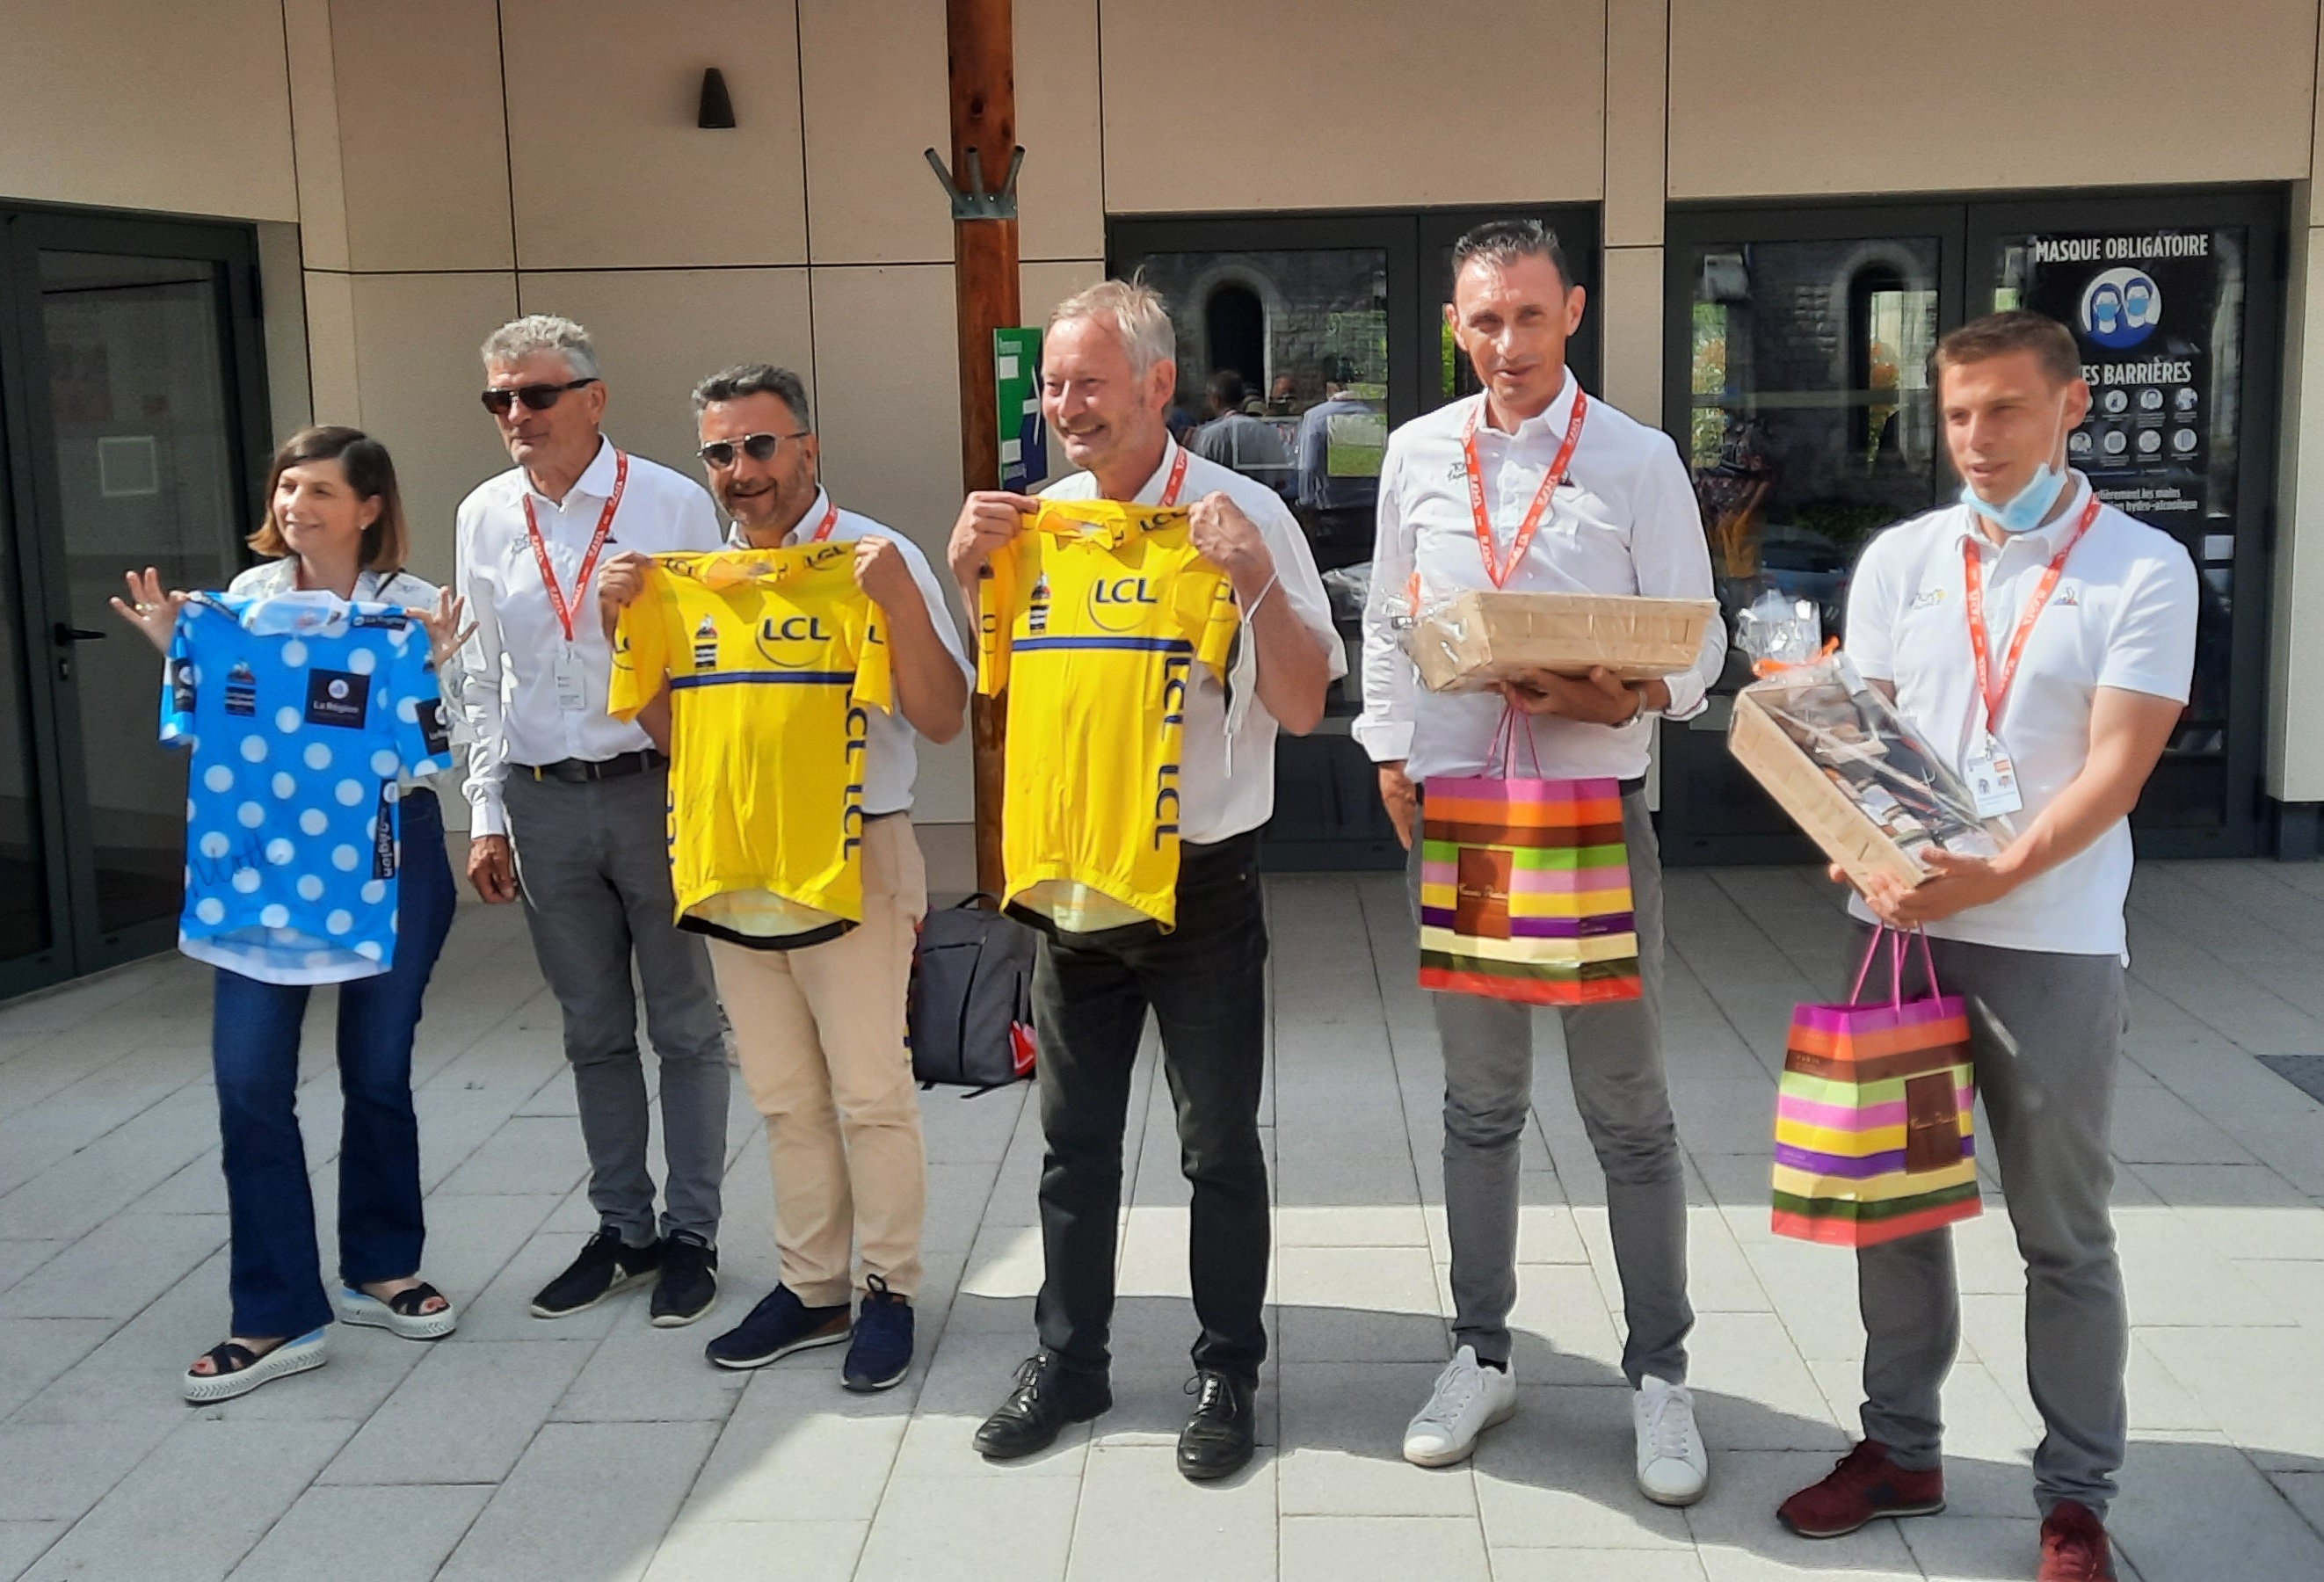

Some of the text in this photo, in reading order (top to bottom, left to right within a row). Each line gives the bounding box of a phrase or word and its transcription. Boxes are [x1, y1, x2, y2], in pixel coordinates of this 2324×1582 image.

[2035, 234, 2209, 263] MASQUE OBLIGATOIRE
[2080, 355, 2192, 386] ES BARRIÈRES
[1095, 578, 1158, 604] LCL
[763, 617, 832, 642] LCL
[1164, 657, 1190, 742] LCL
[843, 784, 864, 862] LCL
[1155, 765, 1180, 851] LCL
